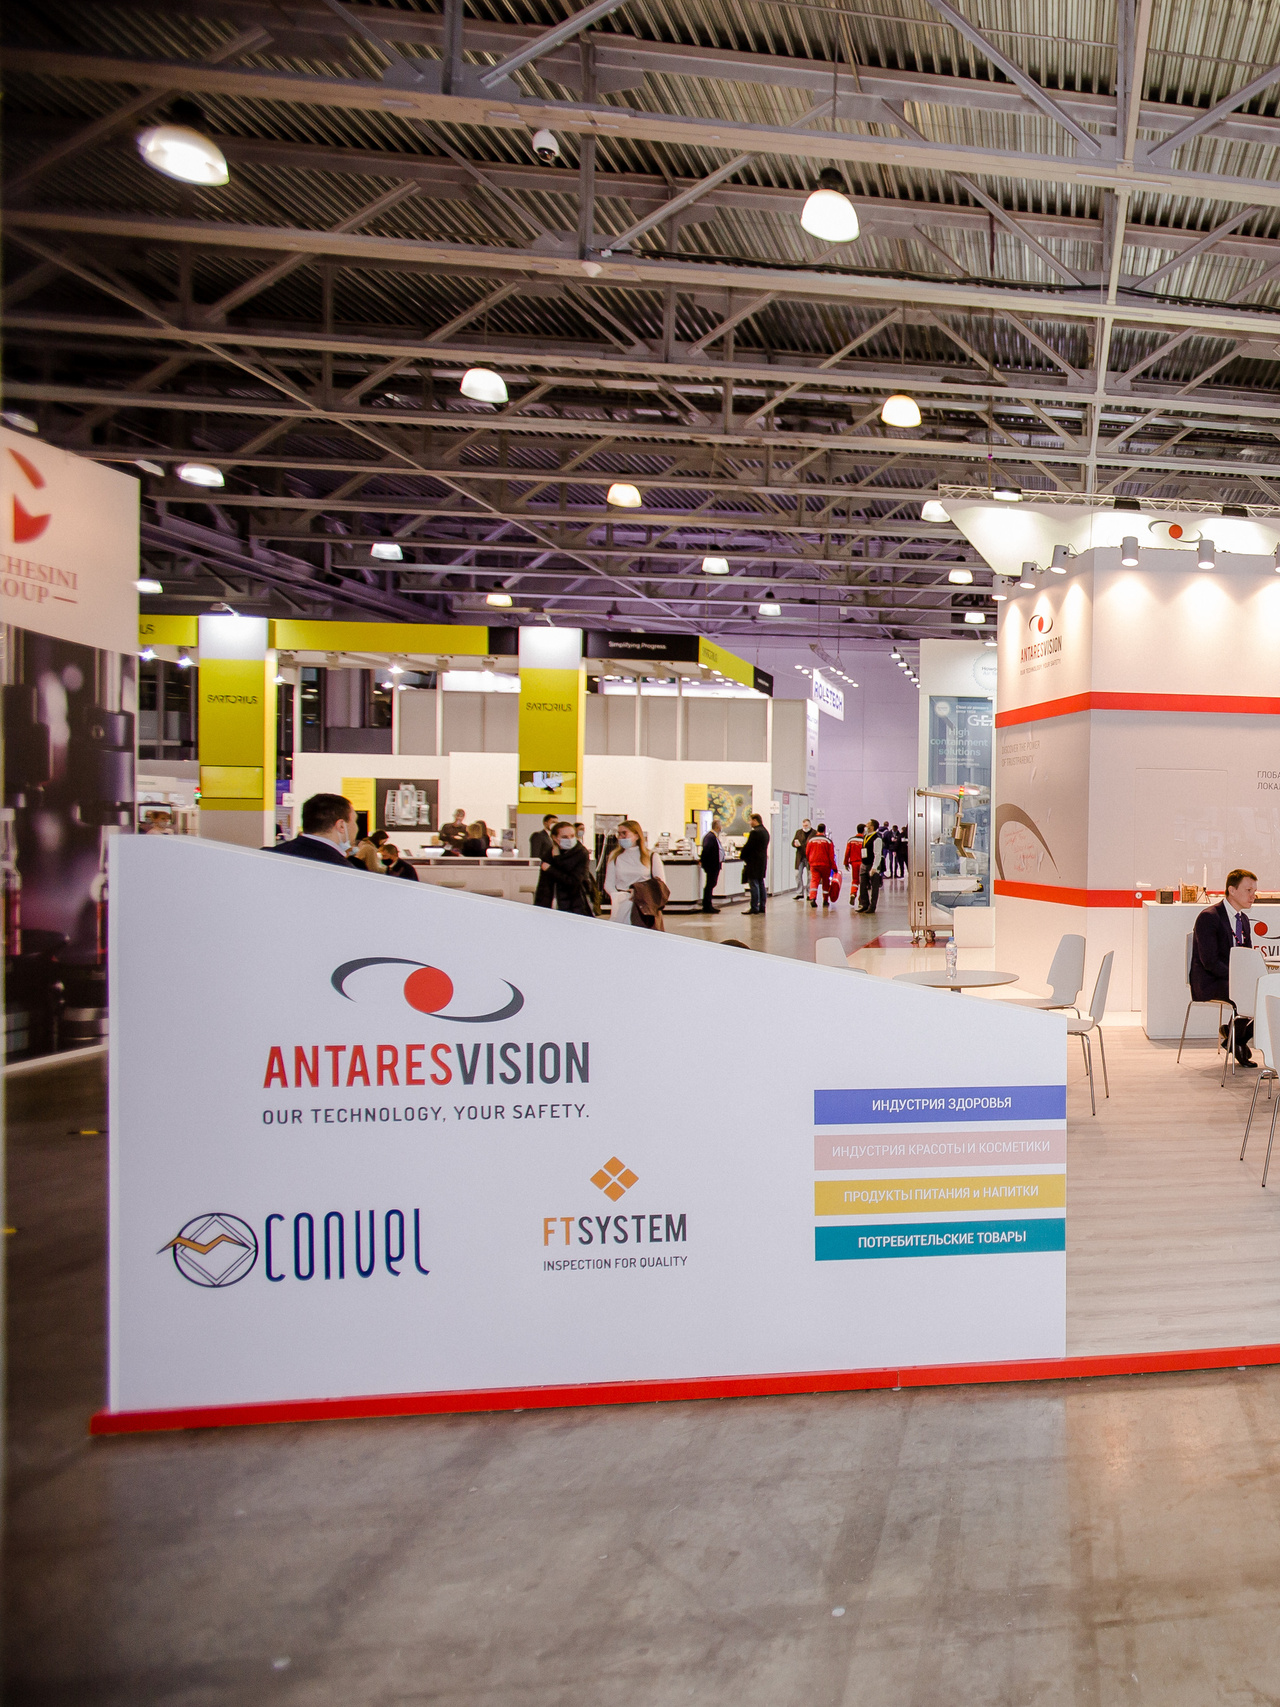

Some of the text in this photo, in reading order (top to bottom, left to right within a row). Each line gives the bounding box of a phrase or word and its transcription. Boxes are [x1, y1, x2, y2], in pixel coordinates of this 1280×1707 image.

[608, 640, 641, 650] Simplifying
[207, 694, 259, 705] SARTORIUS
[526, 702, 572, 712] SARTORIUS
[949, 728, 970, 738] High
[930, 738, 988, 747] containment
[938, 748, 981, 756] solutions
[262, 1042, 590, 1089] ANTARESVISION
[872, 1097, 1012, 1112] ИНДУСТРИЯ ЗДОРОВЬЯ
[262, 1104, 590, 1125] OUR TECHNOLOGY, YOUR SAFETY.
[832, 1141, 1050, 1159] ИНДУСТРИЯ КРАСОТЫ И КОСМЕТИКИ
[844, 1185, 1039, 1204] ПРОДУКТЫ ПИТАНИЯ и НАПИТКИ
[543, 1213, 688, 1247] FTSYSTEM
[858, 1231, 1027, 1248] ПОТРЕБИТЕЛЬСКИЕ ТОВАРЫ
[543, 1255, 688, 1272] INSPECTION FOR QUALITY
